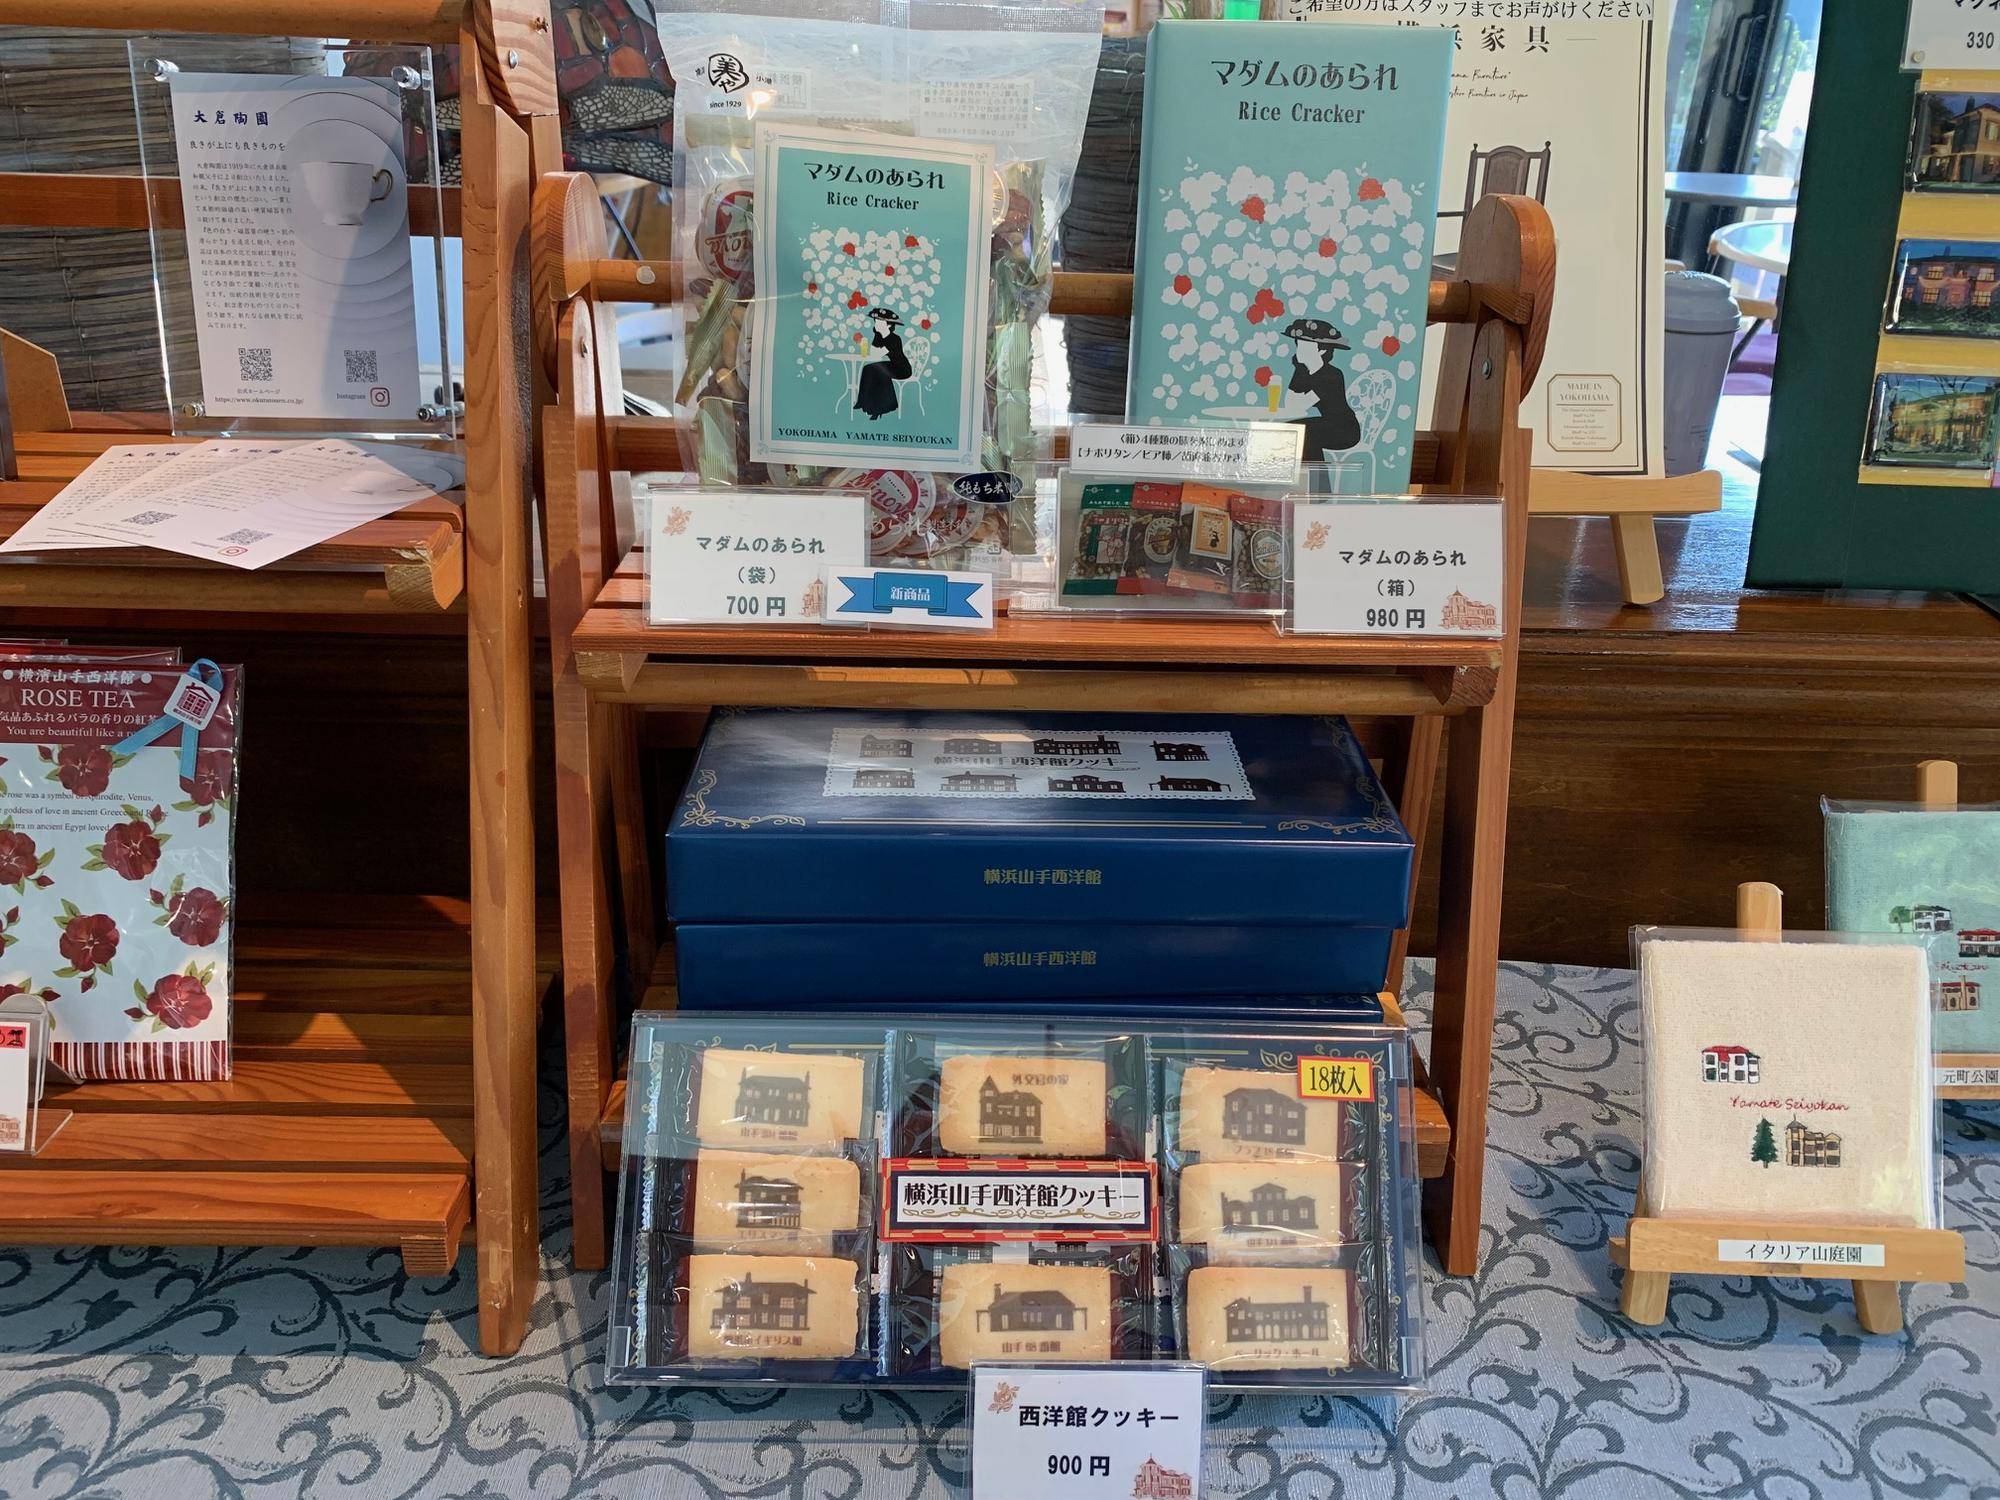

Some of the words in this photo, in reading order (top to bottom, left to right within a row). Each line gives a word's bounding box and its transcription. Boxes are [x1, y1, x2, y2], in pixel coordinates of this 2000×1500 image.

[1966, 32, 1995, 49] 330
[1211, 60, 1400, 92] マダムのあられ
[709, 101, 725, 109] since
[726, 100, 742, 108] 1929
[1238, 101, 1282, 122] Rice
[1292, 102, 1366, 124] Cracker
[193, 110, 269, 126] 大倉陶園
[189, 140, 286, 152] 良きが上にも良きものを
[803, 161, 946, 190] マダムのあられ
[826, 191, 858, 208] Rice
[865, 193, 920, 211] Cracker
[1567, 383, 1589, 391] MADE
[1559, 393, 1610, 401] YOKOHAMA
[778, 426, 838, 439] YOKOHAMA
[845, 431, 890, 443] YAMATE
[892, 433, 953, 446] SEIYOUKAN
[696, 535, 826, 554] マダムのあられ
[1338, 549, 1467, 567] マダムのあられ
[737, 565, 777, 585] （袋）
[890, 585, 930, 602] 新商品
[1376, 578, 1417, 597] （箱）
[18, 668, 136, 685] 横濱山手西洋館
[20, 688, 83, 707] ROSE
[89, 690, 136, 709] TEA
[7, 726, 27, 736] You
[30, 728, 46, 736] are
[48, 727, 93, 737] beautiful
[95, 727, 115, 737] like
[46, 792, 73, 801] symbol
[3, 806, 33, 816] goddess
[35, 806, 43, 814] of
[45, 806, 61, 815] love
[62, 807, 69, 815] in
[71, 807, 98, 815] ancient
[100, 808, 127, 816] Greece
[65, 823, 87, 833] Egypt
[983, 868, 1102, 885] 横浜山手西洋館
[983, 950, 1097, 967] 横浜山手西洋館
[1309, 1064, 1363, 1096] 18枚入
[1943, 1069, 1999, 1084] 元町公園
[1730, 1095, 1783, 1109] Yamate
[904, 1181, 1140, 1209] 横浜山手西洋館クッキー
[1744, 1244, 1863, 1263] イタリア山庭園
[1018, 1404, 1180, 1428] 西洋館クッキー
